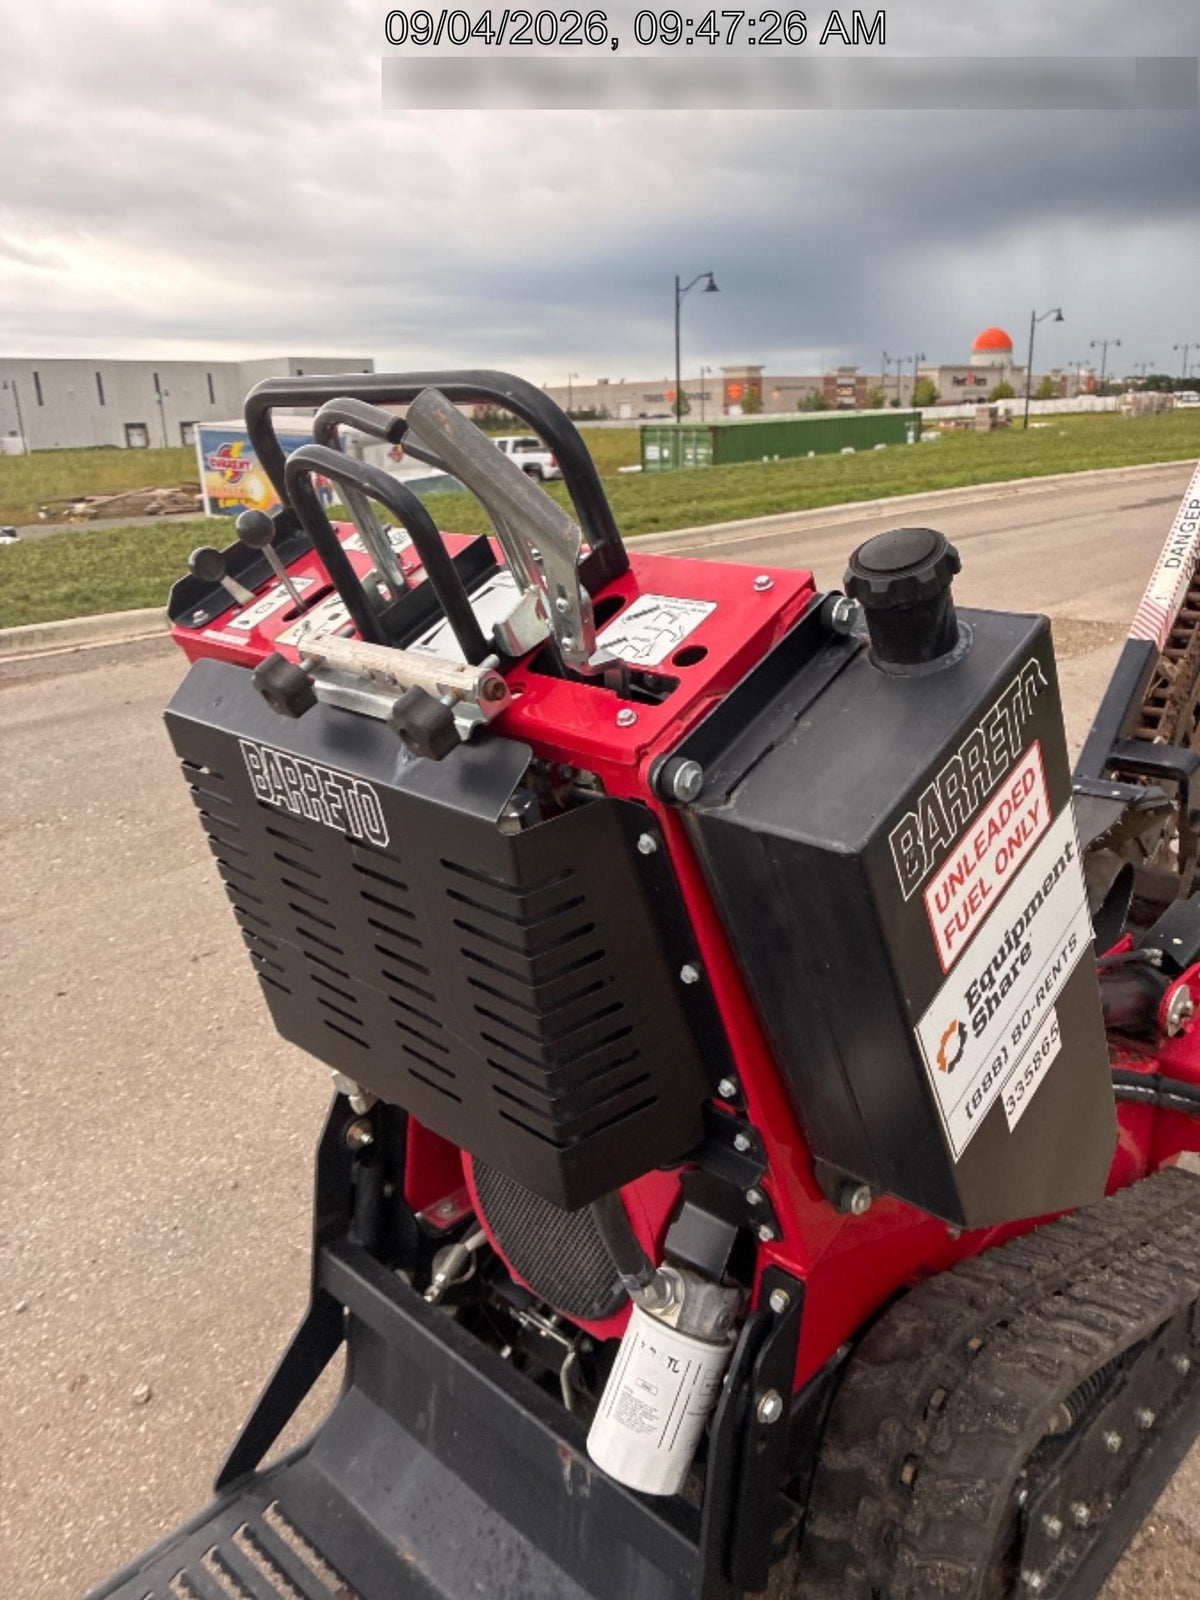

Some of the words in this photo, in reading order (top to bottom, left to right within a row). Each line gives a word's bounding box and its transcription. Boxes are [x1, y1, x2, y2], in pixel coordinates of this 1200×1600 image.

[238, 739, 389, 848] BARRETO
[934, 767, 1036, 914] UNLEADED
[943, 880, 992, 949] FUEL
[994, 798, 1041, 875] ONLY
[964, 841, 1074, 1015] Equipment
[965, 1047, 1009, 1120] (888)
[1011, 933, 1078, 1045] 80-RENTS
[971, 942, 1032, 1038] Share
[1005, 1022, 1059, 1116] 335865
